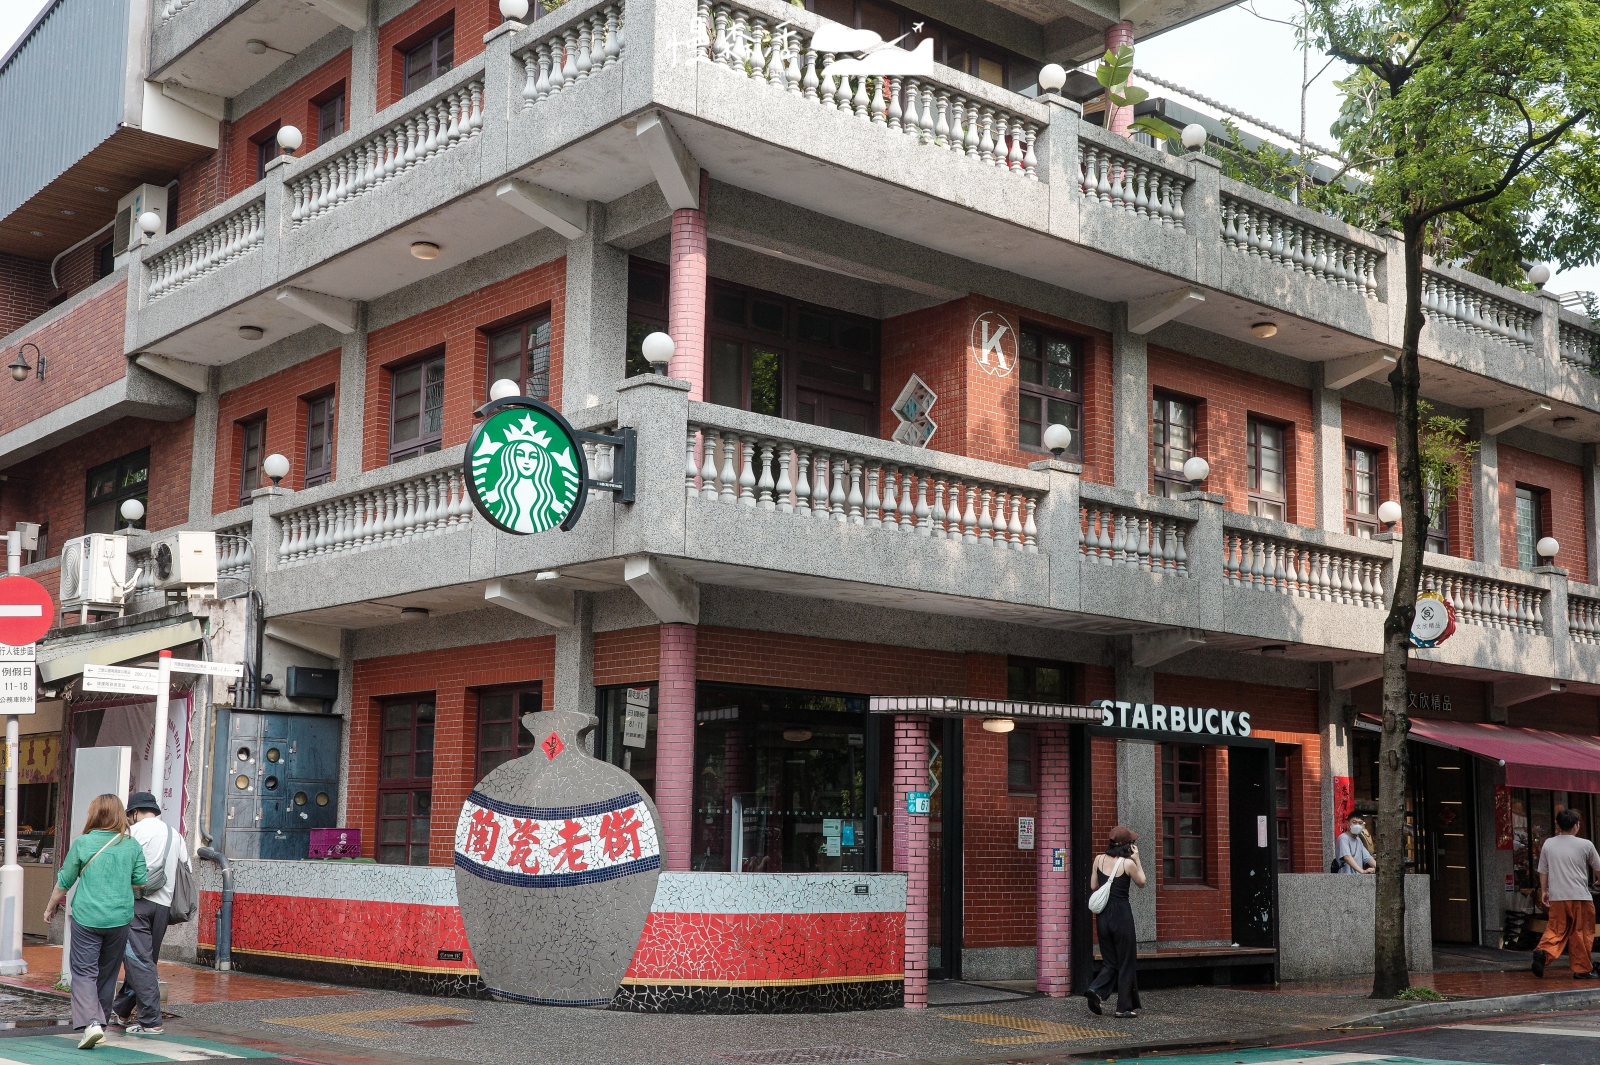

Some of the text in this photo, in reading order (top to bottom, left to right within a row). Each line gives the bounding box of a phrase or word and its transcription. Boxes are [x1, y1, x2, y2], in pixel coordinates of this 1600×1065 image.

[979, 319, 1010, 371] K
[1416, 622, 1440, 630] 文欣精品
[0, 646, 34, 656] 行人徒步區
[2, 667, 32, 677] 例假日
[5, 682, 28, 691] 11-18
[1408, 690, 1452, 711] 文欣精品
[1100, 699, 1251, 737] STARBUCKS
[464, 807, 643, 875] 陶瓷老街
